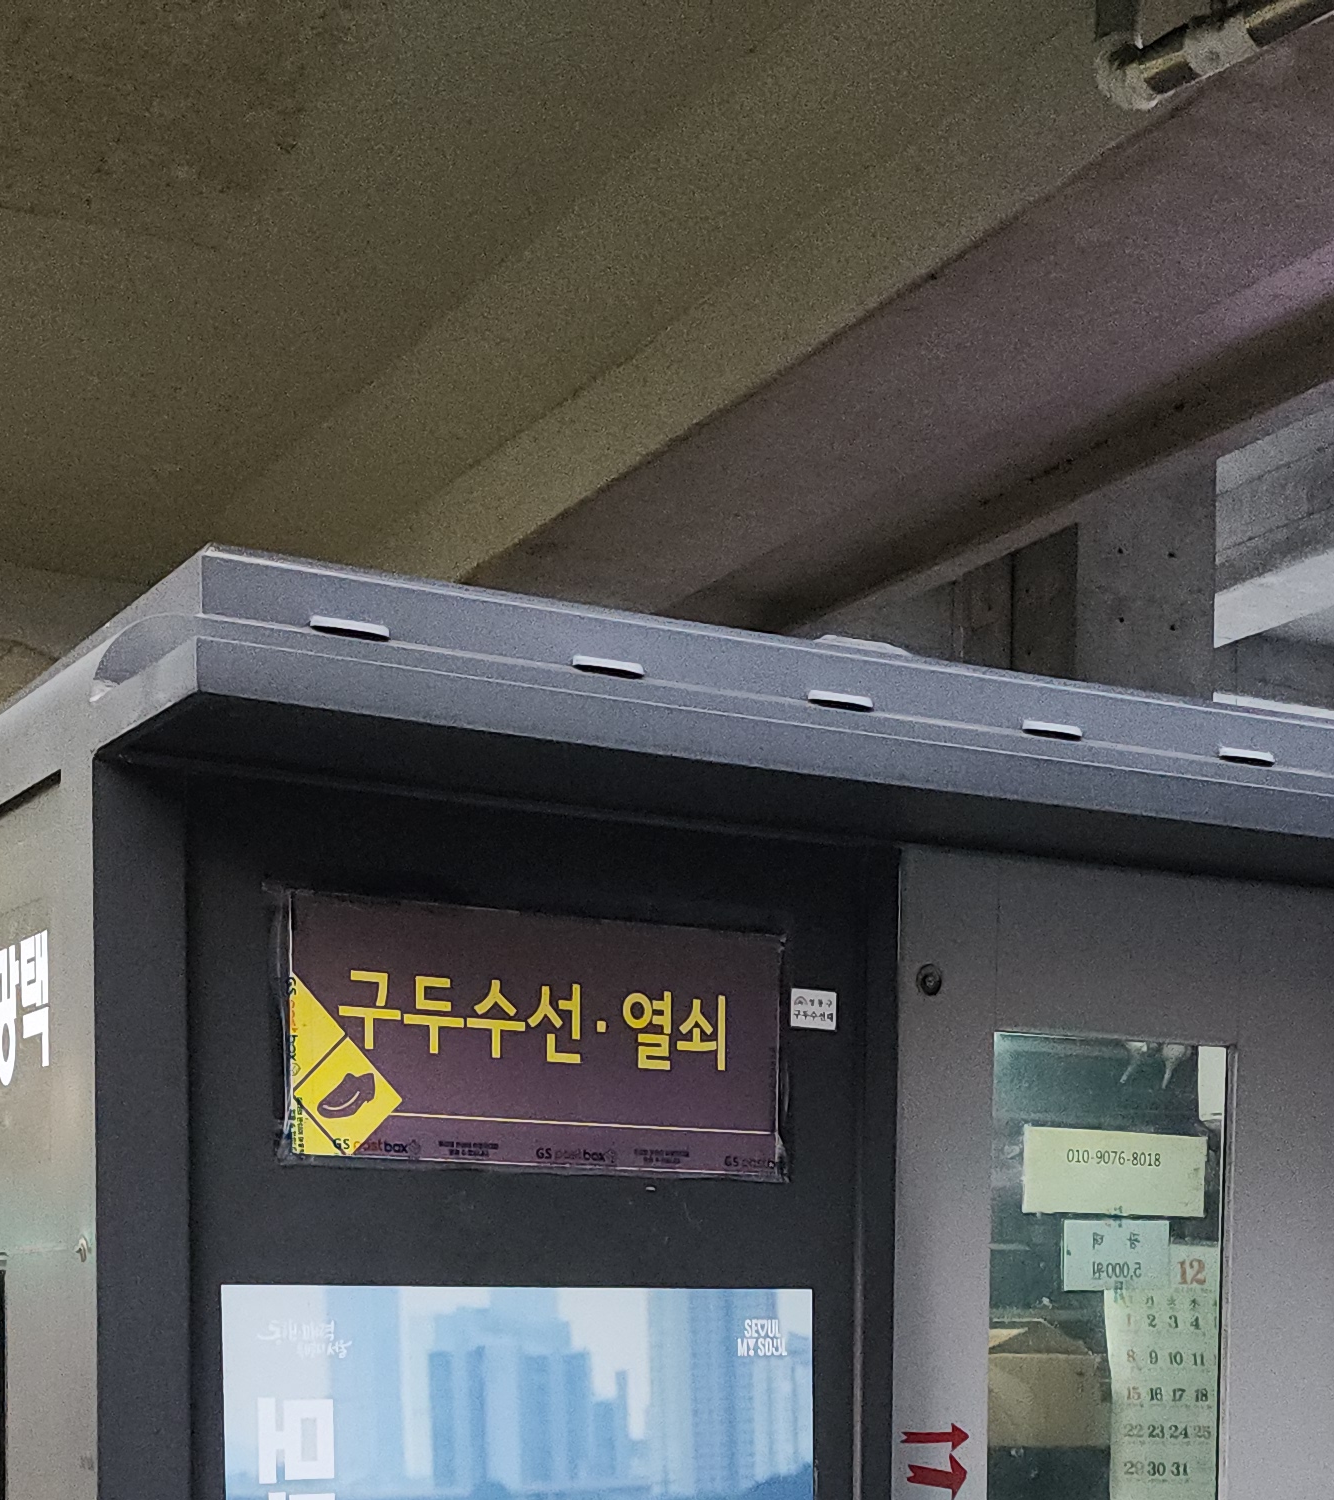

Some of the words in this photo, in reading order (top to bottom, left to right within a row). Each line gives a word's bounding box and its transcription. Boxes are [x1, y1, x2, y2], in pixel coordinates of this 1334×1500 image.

[338, 968, 728, 1072] 구두수선·열쇠
[1066, 1147, 1161, 1168] 010-9076-8018
[1177, 1258, 1207, 1286] 12
[1147, 1314, 1157, 1329] 2
[1168, 1315, 1179, 1329] 3
[1189, 1315, 1201, 1330] 4
[758, 1337, 788, 1357] SOUL
[1126, 1349, 1137, 1363] 8
[1149, 1349, 1159, 1365] 9
[1168, 1351, 1184, 1366] 10
[1191, 1352, 1206, 1367] 11
[1126, 1386, 1142, 1401] 15
[1149, 1387, 1164, 1402] 16
[1172, 1388, 1186, 1402] 17
[1194, 1388, 1209, 1402] 18
[1123, 1423, 1144, 1437] 22
[1147, 1424, 1165, 1439] 23
[1169, 1424, 1190, 1440] 24
[1147, 1462, 1166, 1477] 30
[1171, 1461, 1189, 1477] 31
